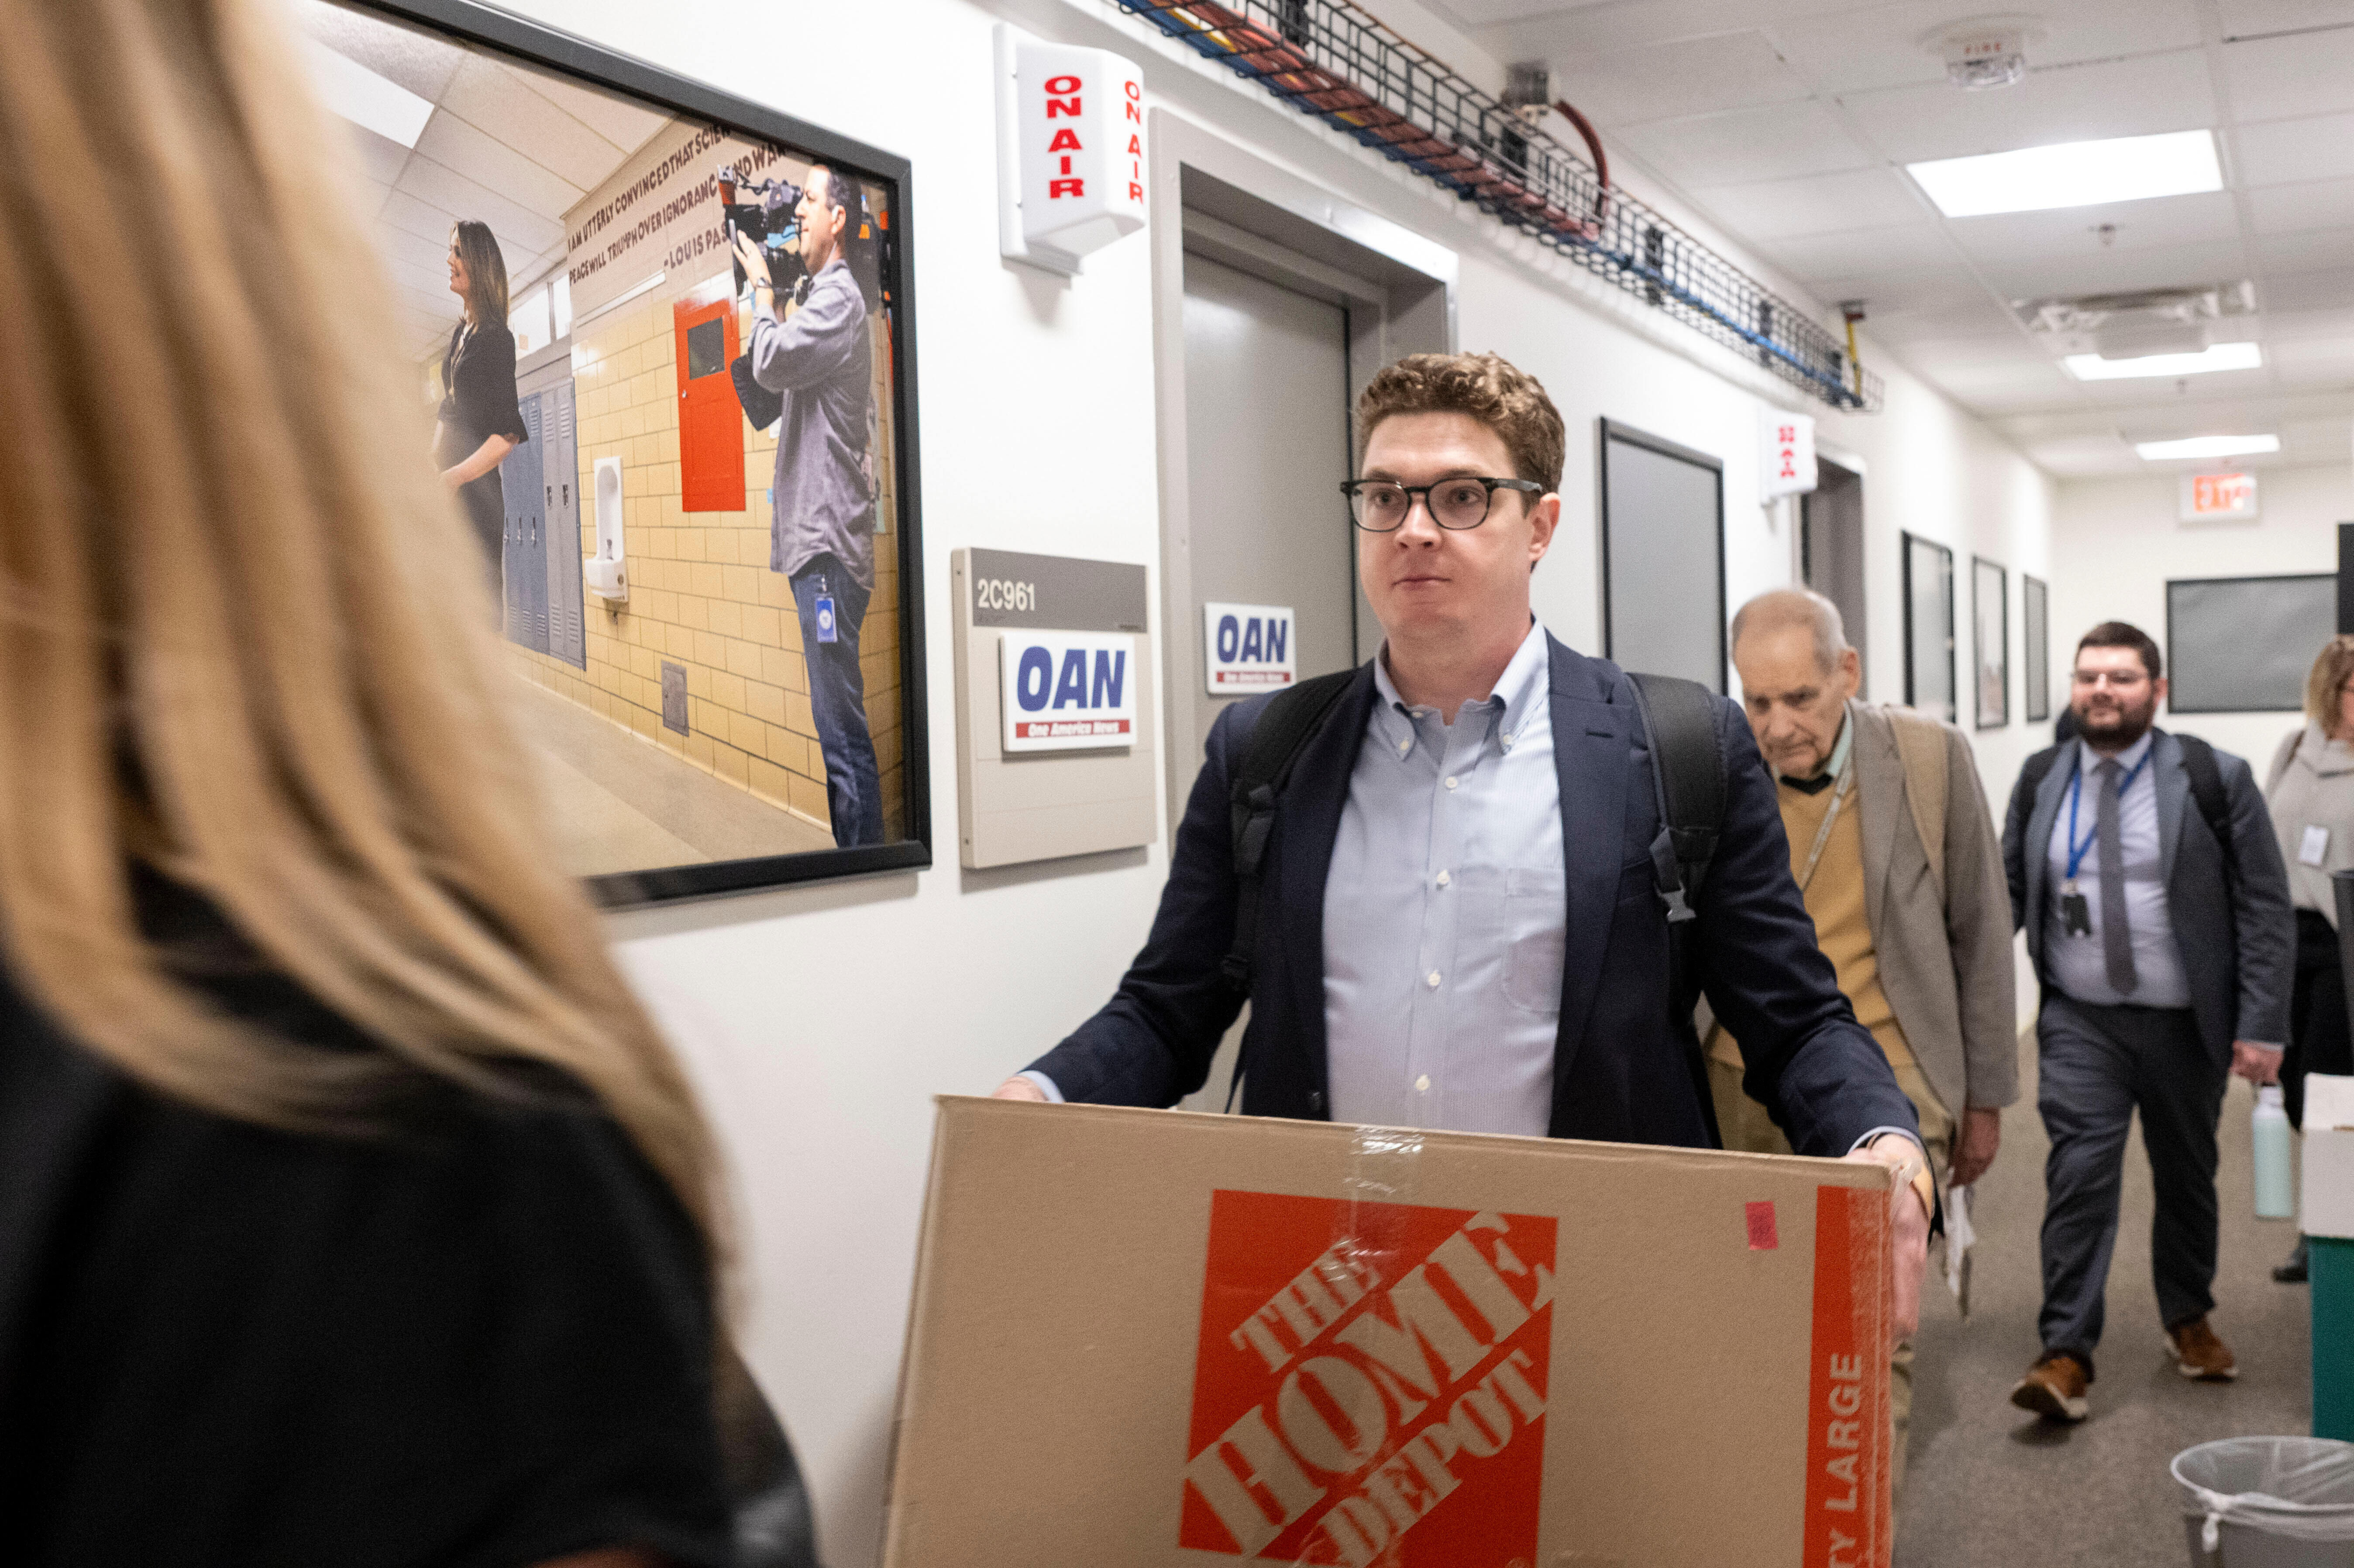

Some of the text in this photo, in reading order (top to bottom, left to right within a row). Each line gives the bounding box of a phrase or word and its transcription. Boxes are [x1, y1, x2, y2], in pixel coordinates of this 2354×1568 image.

[572, 230, 582, 252] AM
[583, 202, 613, 242] UTTERLY
[615, 161, 669, 214] CONVINCED
[669, 139, 694, 174] THAT
[1044, 76, 1084, 199] ON AIR
[1125, 81, 1143, 204] ON AIR
[589, 252, 606, 274] WILL
[638, 211, 662, 240] OVER
[662, 174, 717, 226] IGNORANC
[977, 578, 1035, 611] 2C961
[1217, 614, 1287, 664] OAN
[1017, 646, 1126, 712] OAN
[1028, 722, 1050, 737] One
[1229, 1235, 1383, 1374] THE
[1185, 1210, 1555, 1558] HOME
[1315, 1348, 1547, 1568] DEPOT
[1825, 1353, 1863, 1568] TY LARGE
